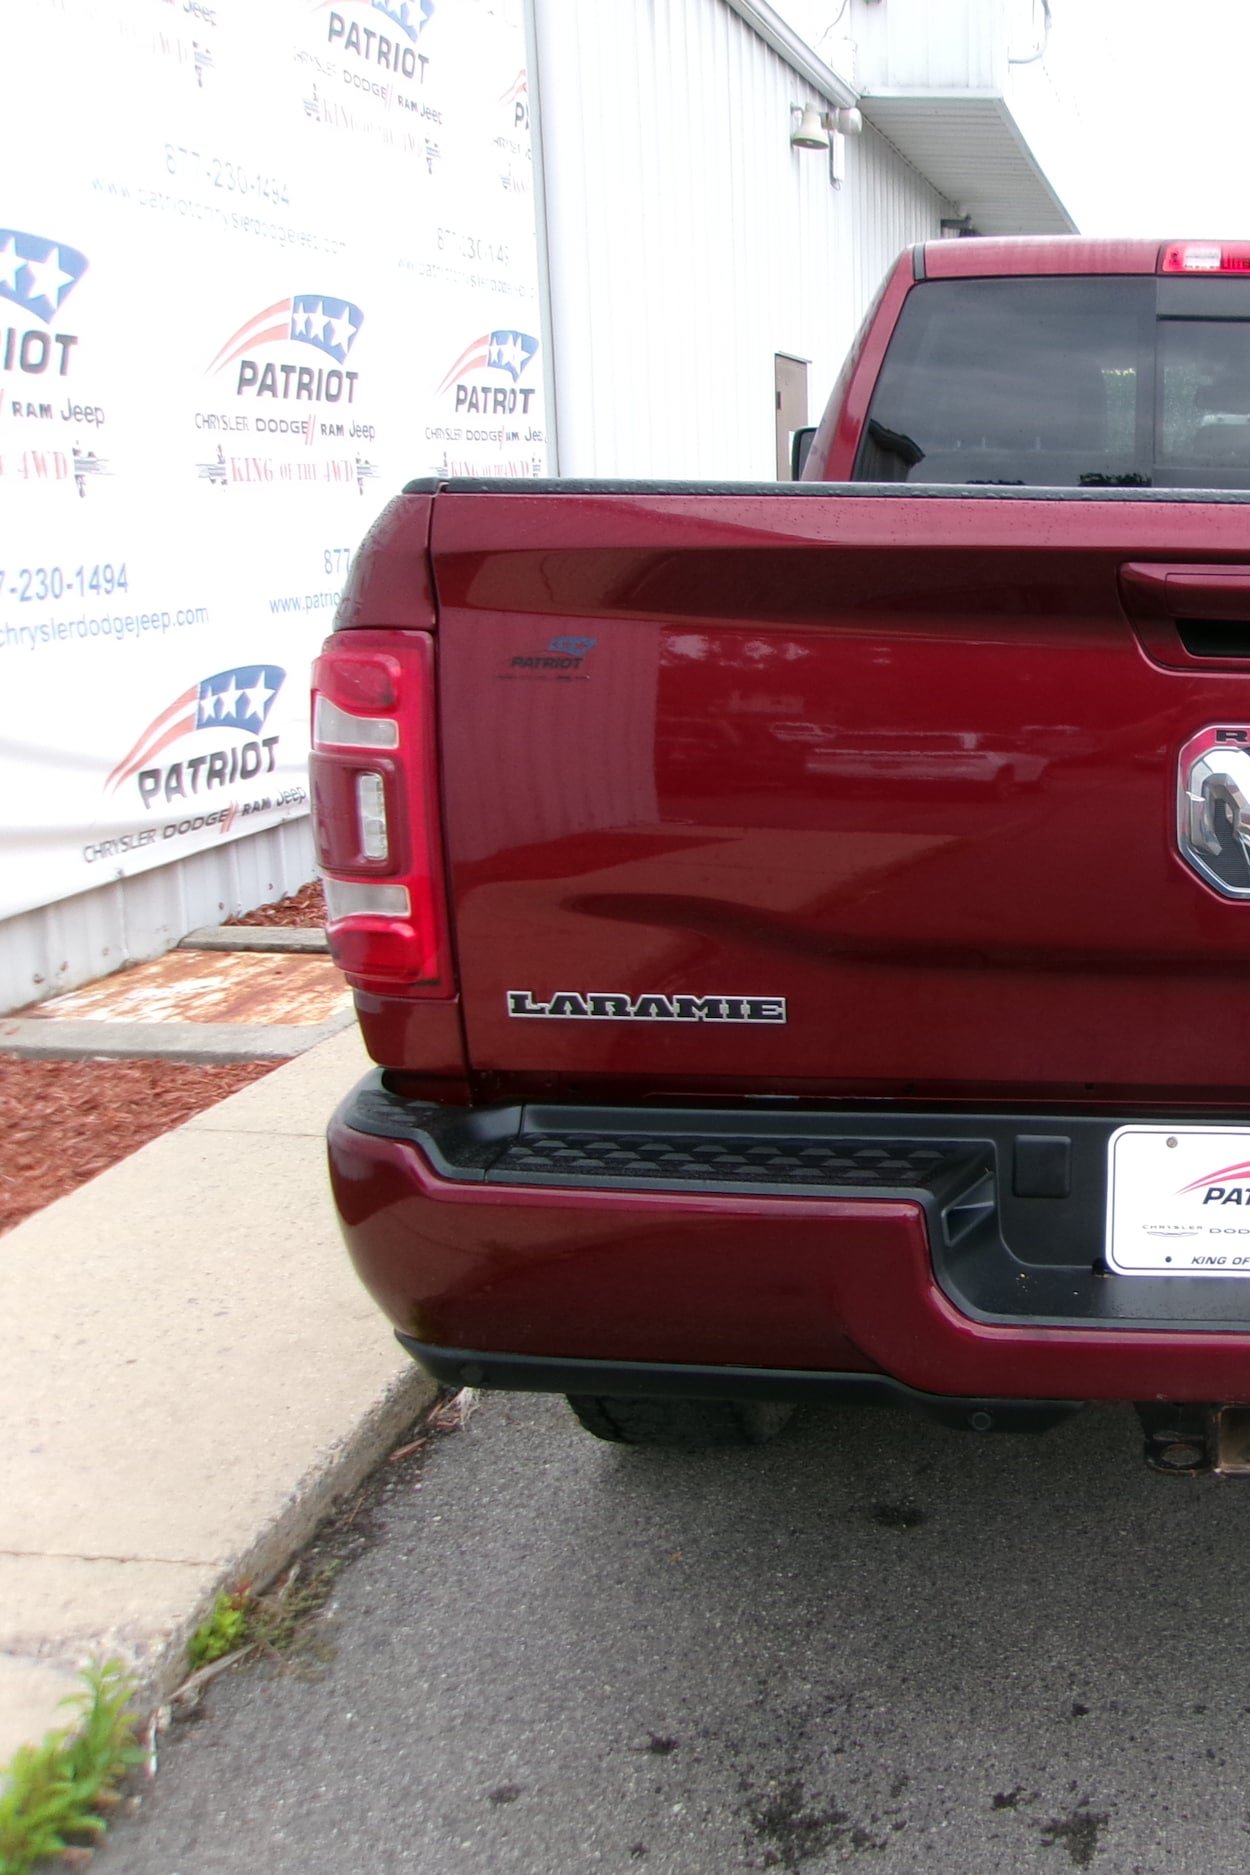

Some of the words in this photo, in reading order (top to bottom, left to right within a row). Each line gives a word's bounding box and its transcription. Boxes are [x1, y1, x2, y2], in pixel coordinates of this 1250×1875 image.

[328, 11, 430, 84] PATRIOT
[343, 69, 387, 100] DODGE
[397, 94, 418, 113] RAM
[236, 359, 359, 404] PATRIOT
[12, 400, 53, 420] RAM
[60, 398, 105, 430] Jeep
[455, 384, 536, 415] PATROT
[195, 412, 249, 433] CHRYSLER
[255, 417, 308, 436] DODGE
[321, 422, 345, 438] RAM
[349, 419, 376, 442] Jeep
[465, 430, 504, 442] DODGE
[230, 456, 274, 483] KING
[323, 459, 354, 484] 4WD
[511, 655, 583, 669] PATRIOT
[138, 735, 279, 810] PATRIOT
[82, 828, 157, 863] CHRYSLER
[163, 808, 231, 841] DODGE
[241, 796, 272, 816] RAM
[276, 786, 307, 808] Jeep
[507, 991, 786, 1023] LARAMIE
[1191, 1255, 1227, 1267] KING
